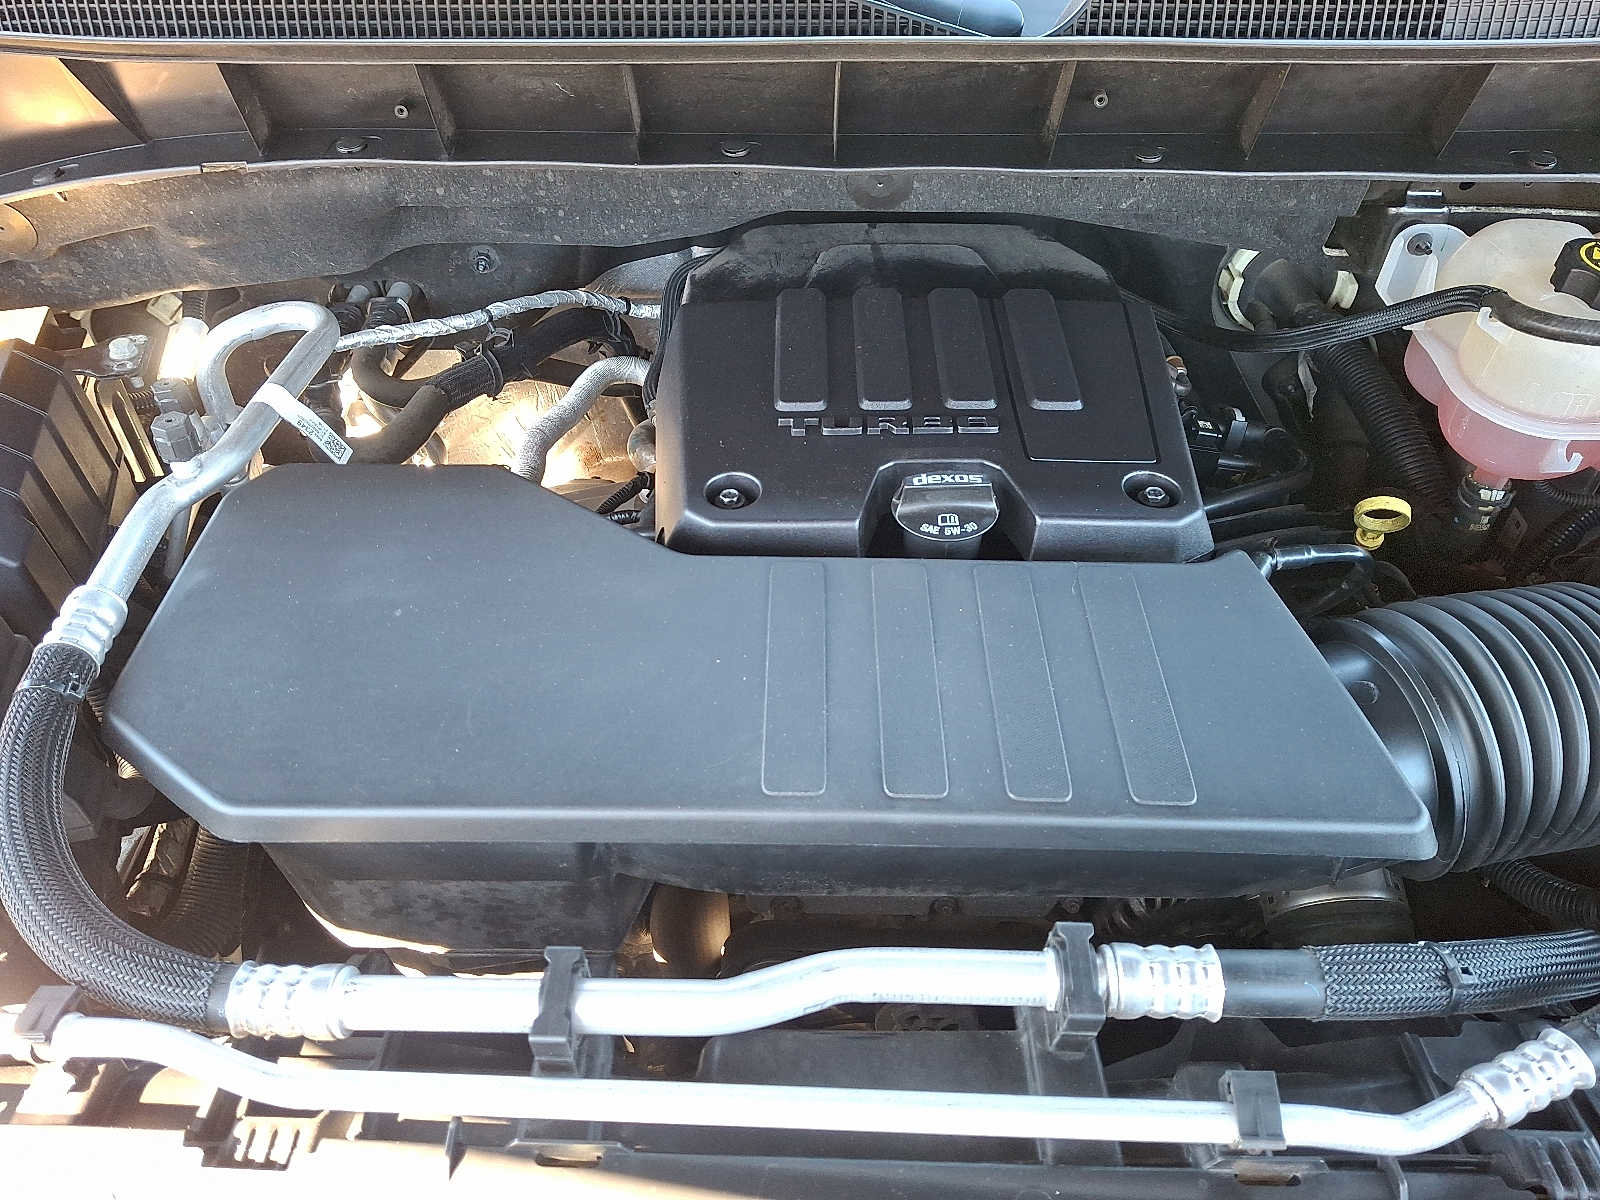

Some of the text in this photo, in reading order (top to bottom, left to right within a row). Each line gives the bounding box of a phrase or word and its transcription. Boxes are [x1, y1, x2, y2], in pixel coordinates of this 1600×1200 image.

[777, 416, 1000, 437] TURBO
[912, 473, 984, 486] dexos
[920, 522, 978, 536] SAE 5W-30
